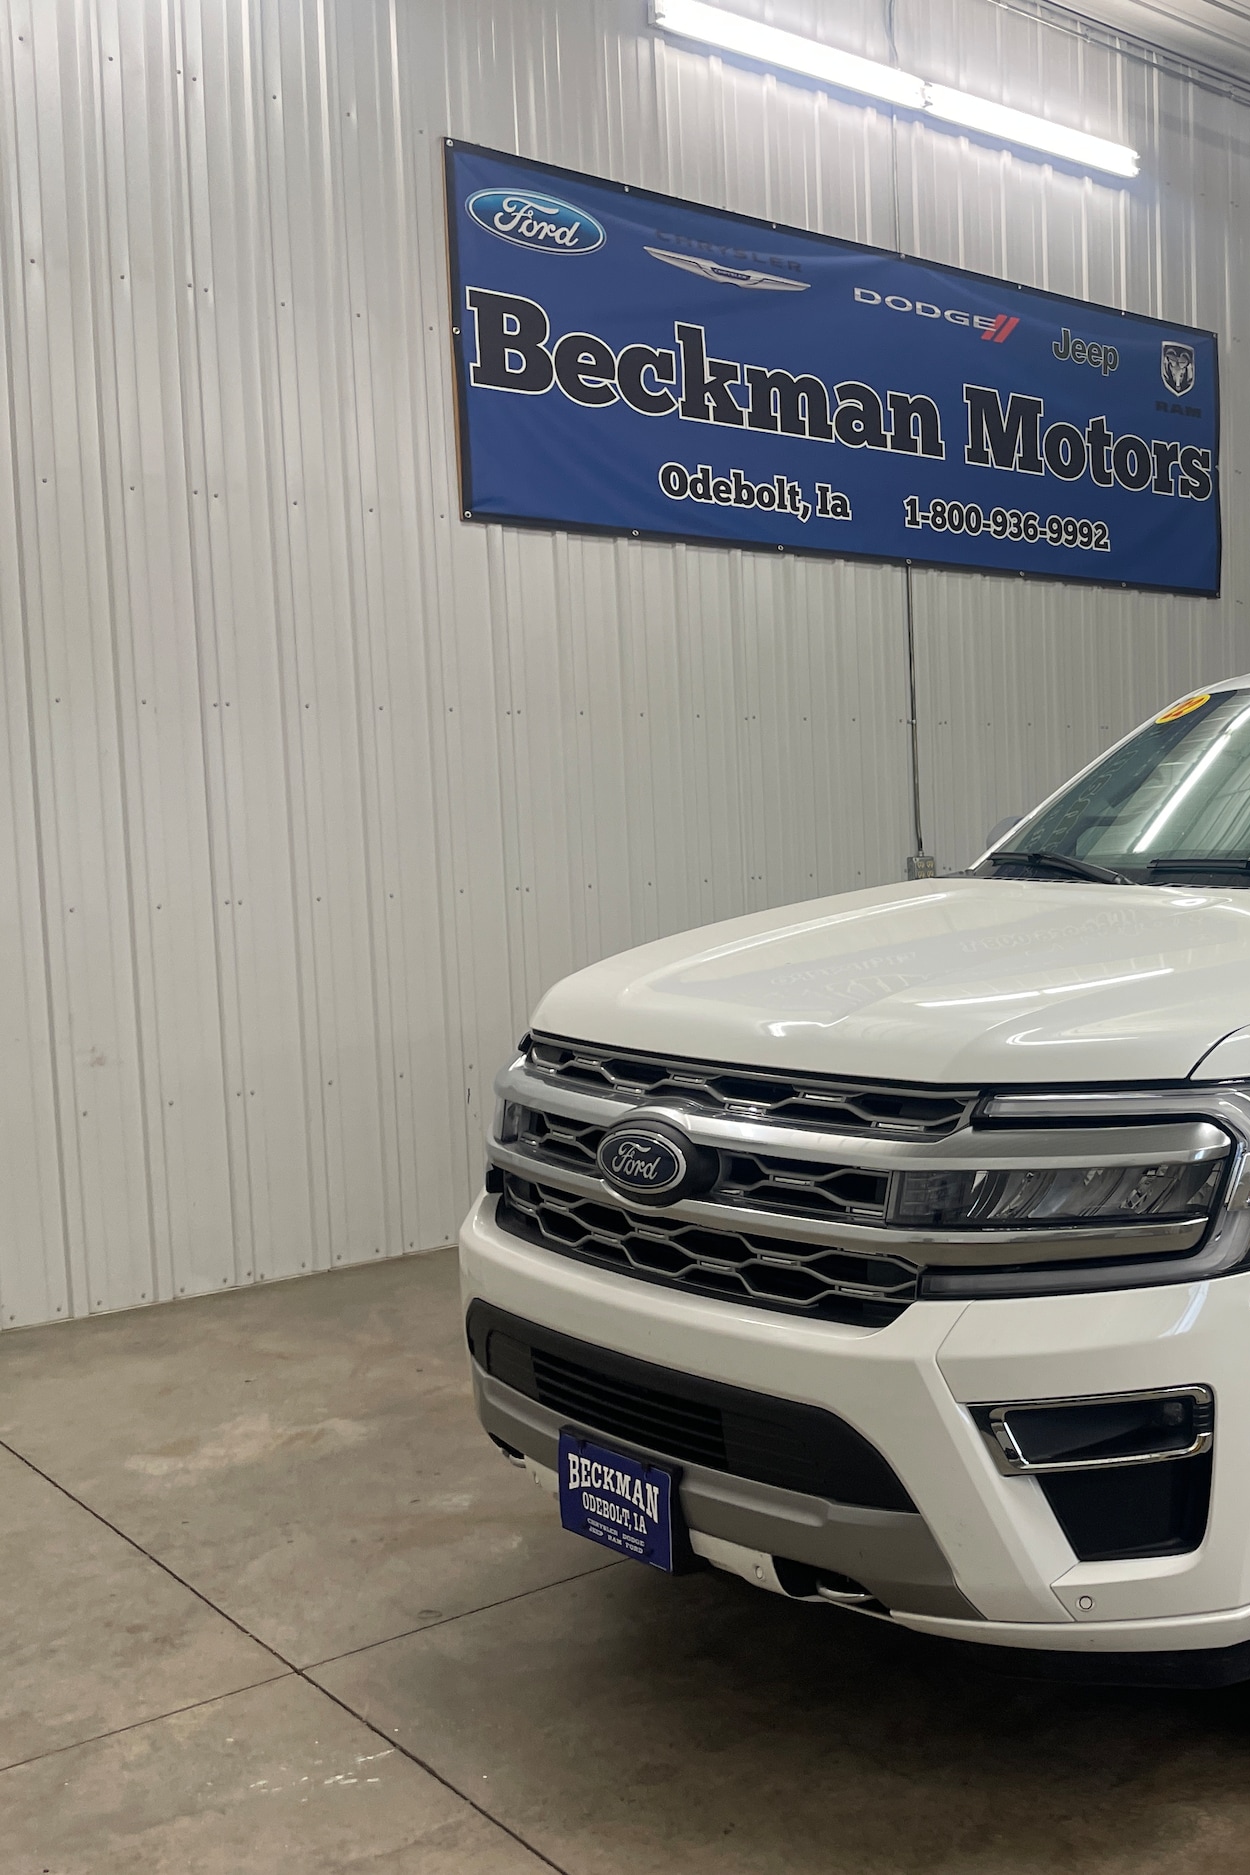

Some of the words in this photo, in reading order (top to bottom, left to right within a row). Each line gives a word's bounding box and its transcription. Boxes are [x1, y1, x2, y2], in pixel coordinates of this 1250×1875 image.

[493, 196, 582, 247] Ford
[655, 230, 803, 273] CHRYSLER
[853, 287, 998, 332] DODGE
[1052, 327, 1119, 376] Jeep
[465, 285, 946, 461] Beckman
[962, 383, 1213, 502] Motors
[1155, 400, 1202, 419] RAM
[658, 461, 811, 524] Odebolt,
[815, 481, 852, 521] Ia
[903, 495, 1112, 552] 1-800-936-9992
[611, 1141, 662, 1180] Ford
[567, 1452, 660, 1524] BECKMAN
[582, 1491, 632, 1531] ODEBOLT,
[633, 1512, 648, 1535] IA
[607, 1534, 622, 1546] RAM
[625, 1541, 643, 1554] FORD
[622, 1533, 645, 1547] DODGE
